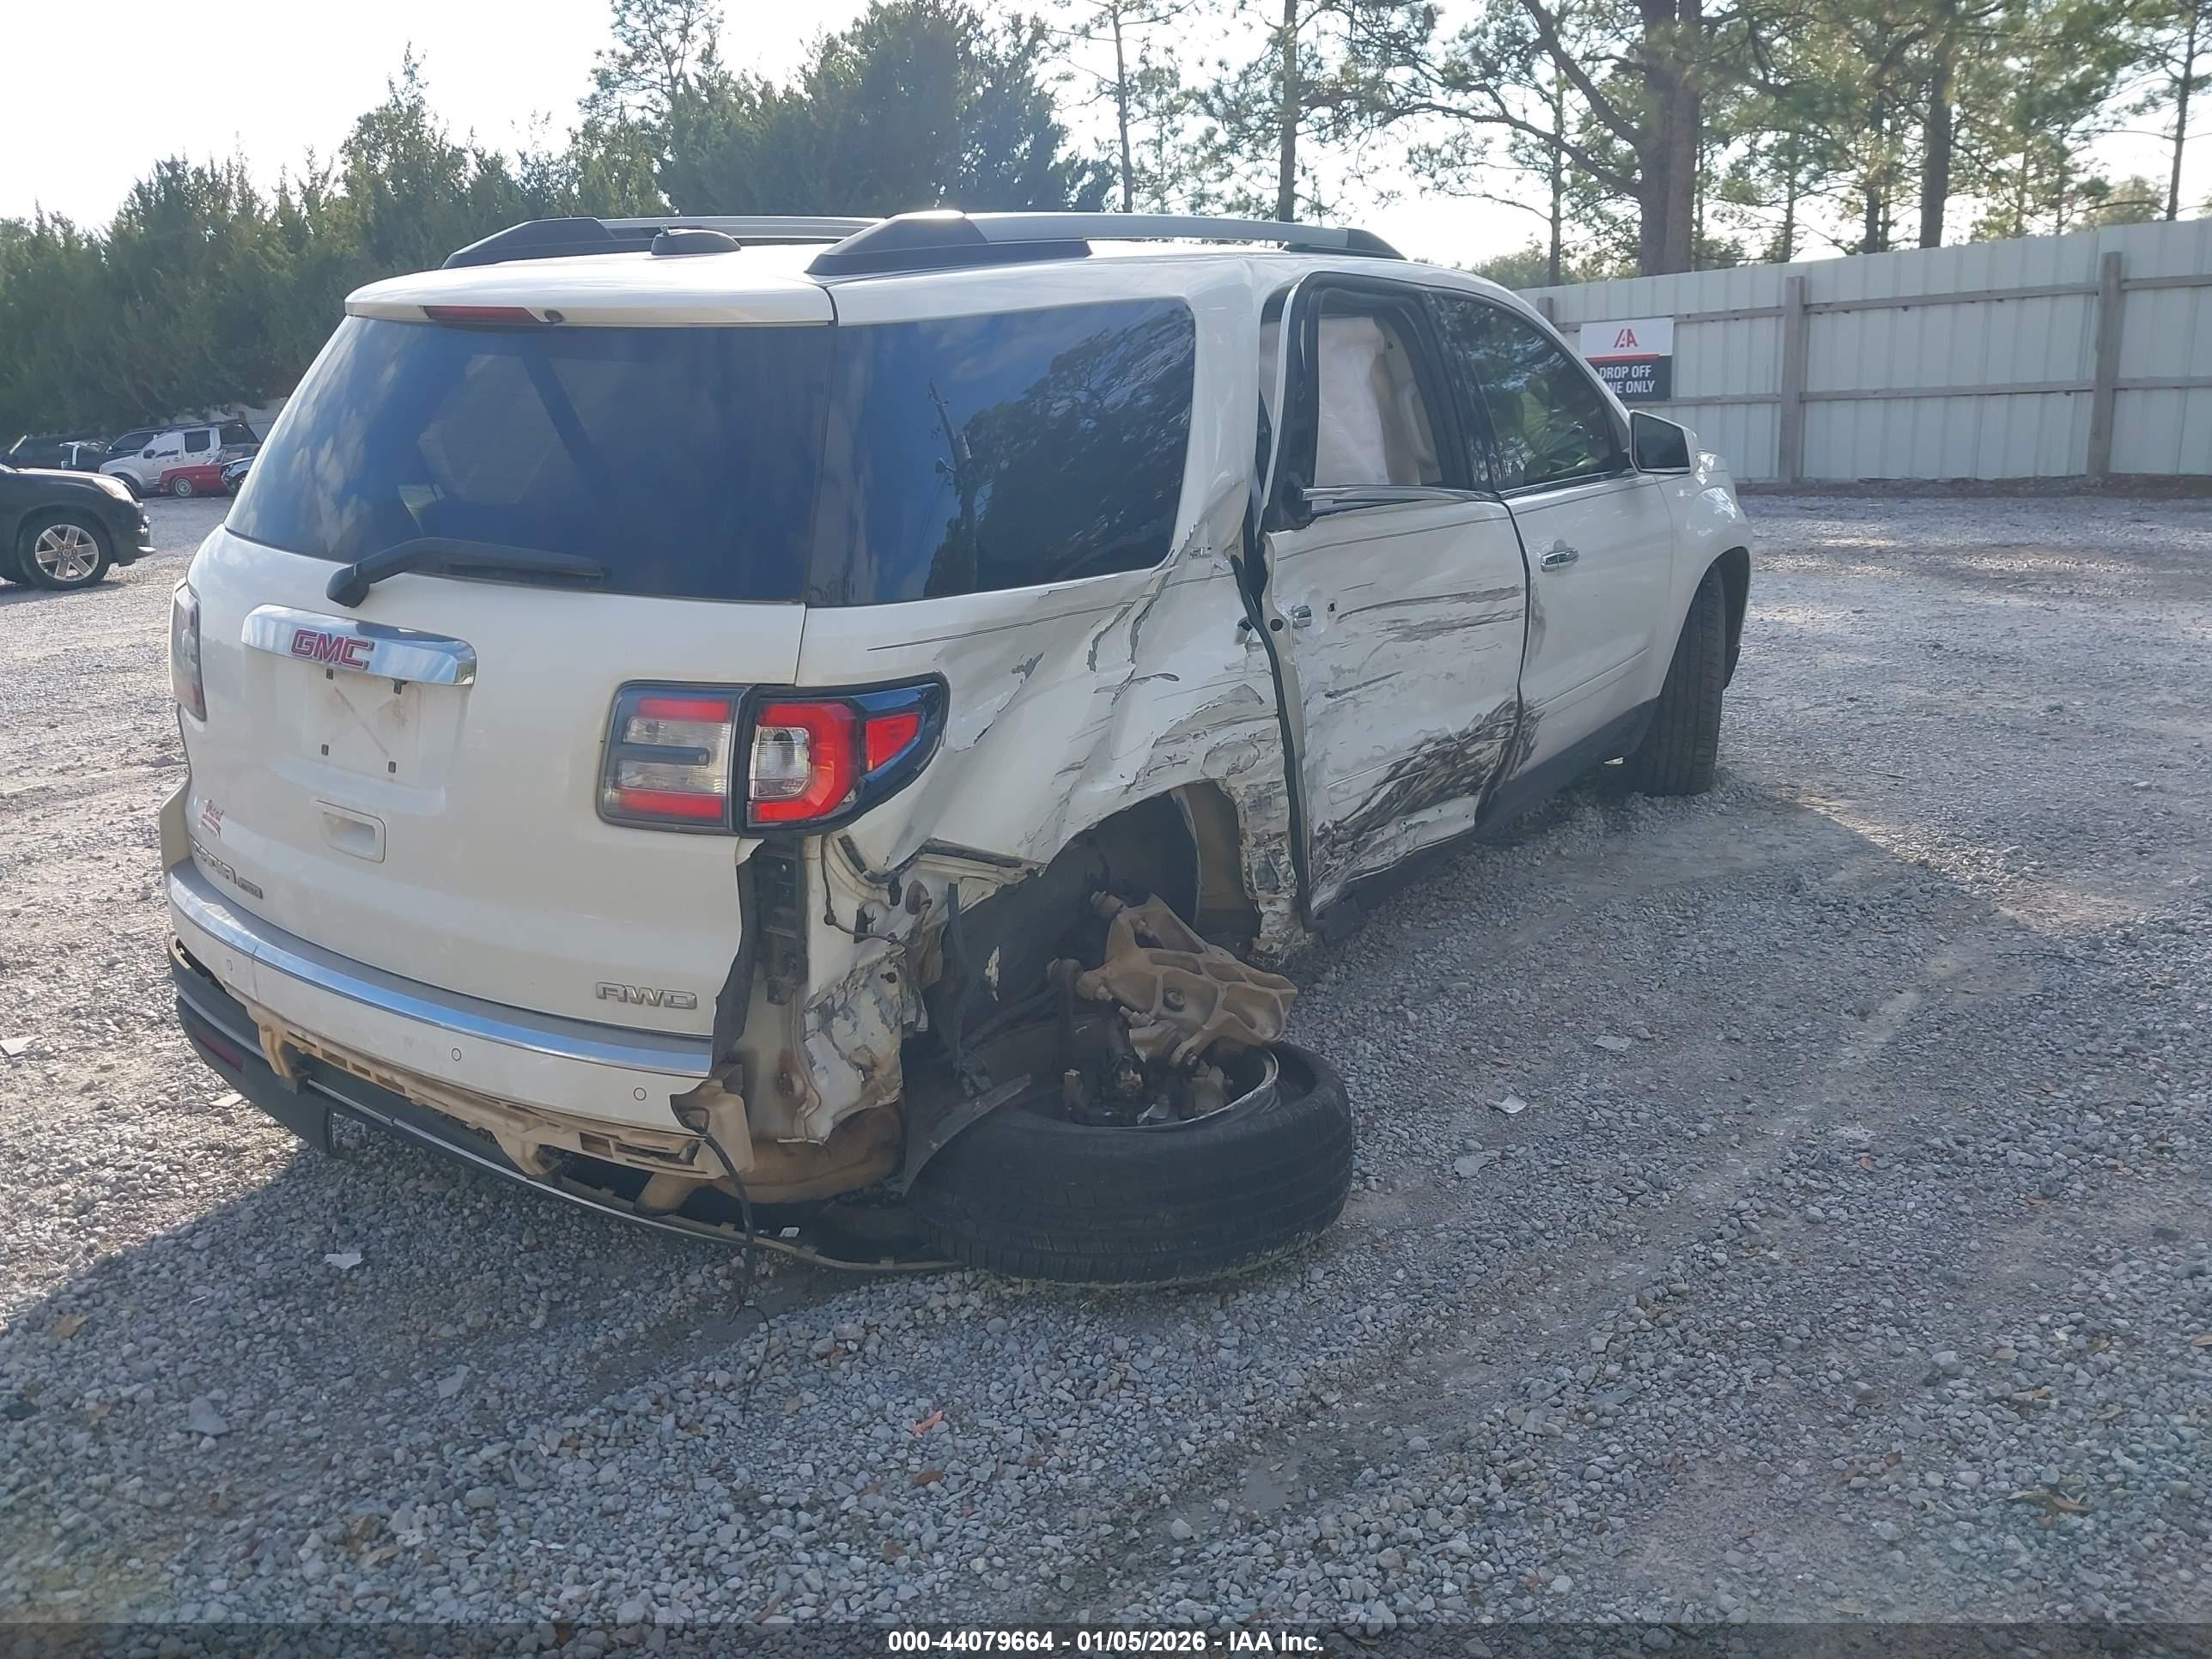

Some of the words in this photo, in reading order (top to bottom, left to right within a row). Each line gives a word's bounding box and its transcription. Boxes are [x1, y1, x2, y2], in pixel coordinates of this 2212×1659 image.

[1599, 366, 1629, 380] DROP
[1632, 365, 1652, 377] OFF
[1626, 380, 1656, 393] ONLY
[290, 629, 374, 671] GMC
[596, 981, 697, 1010] AWD
